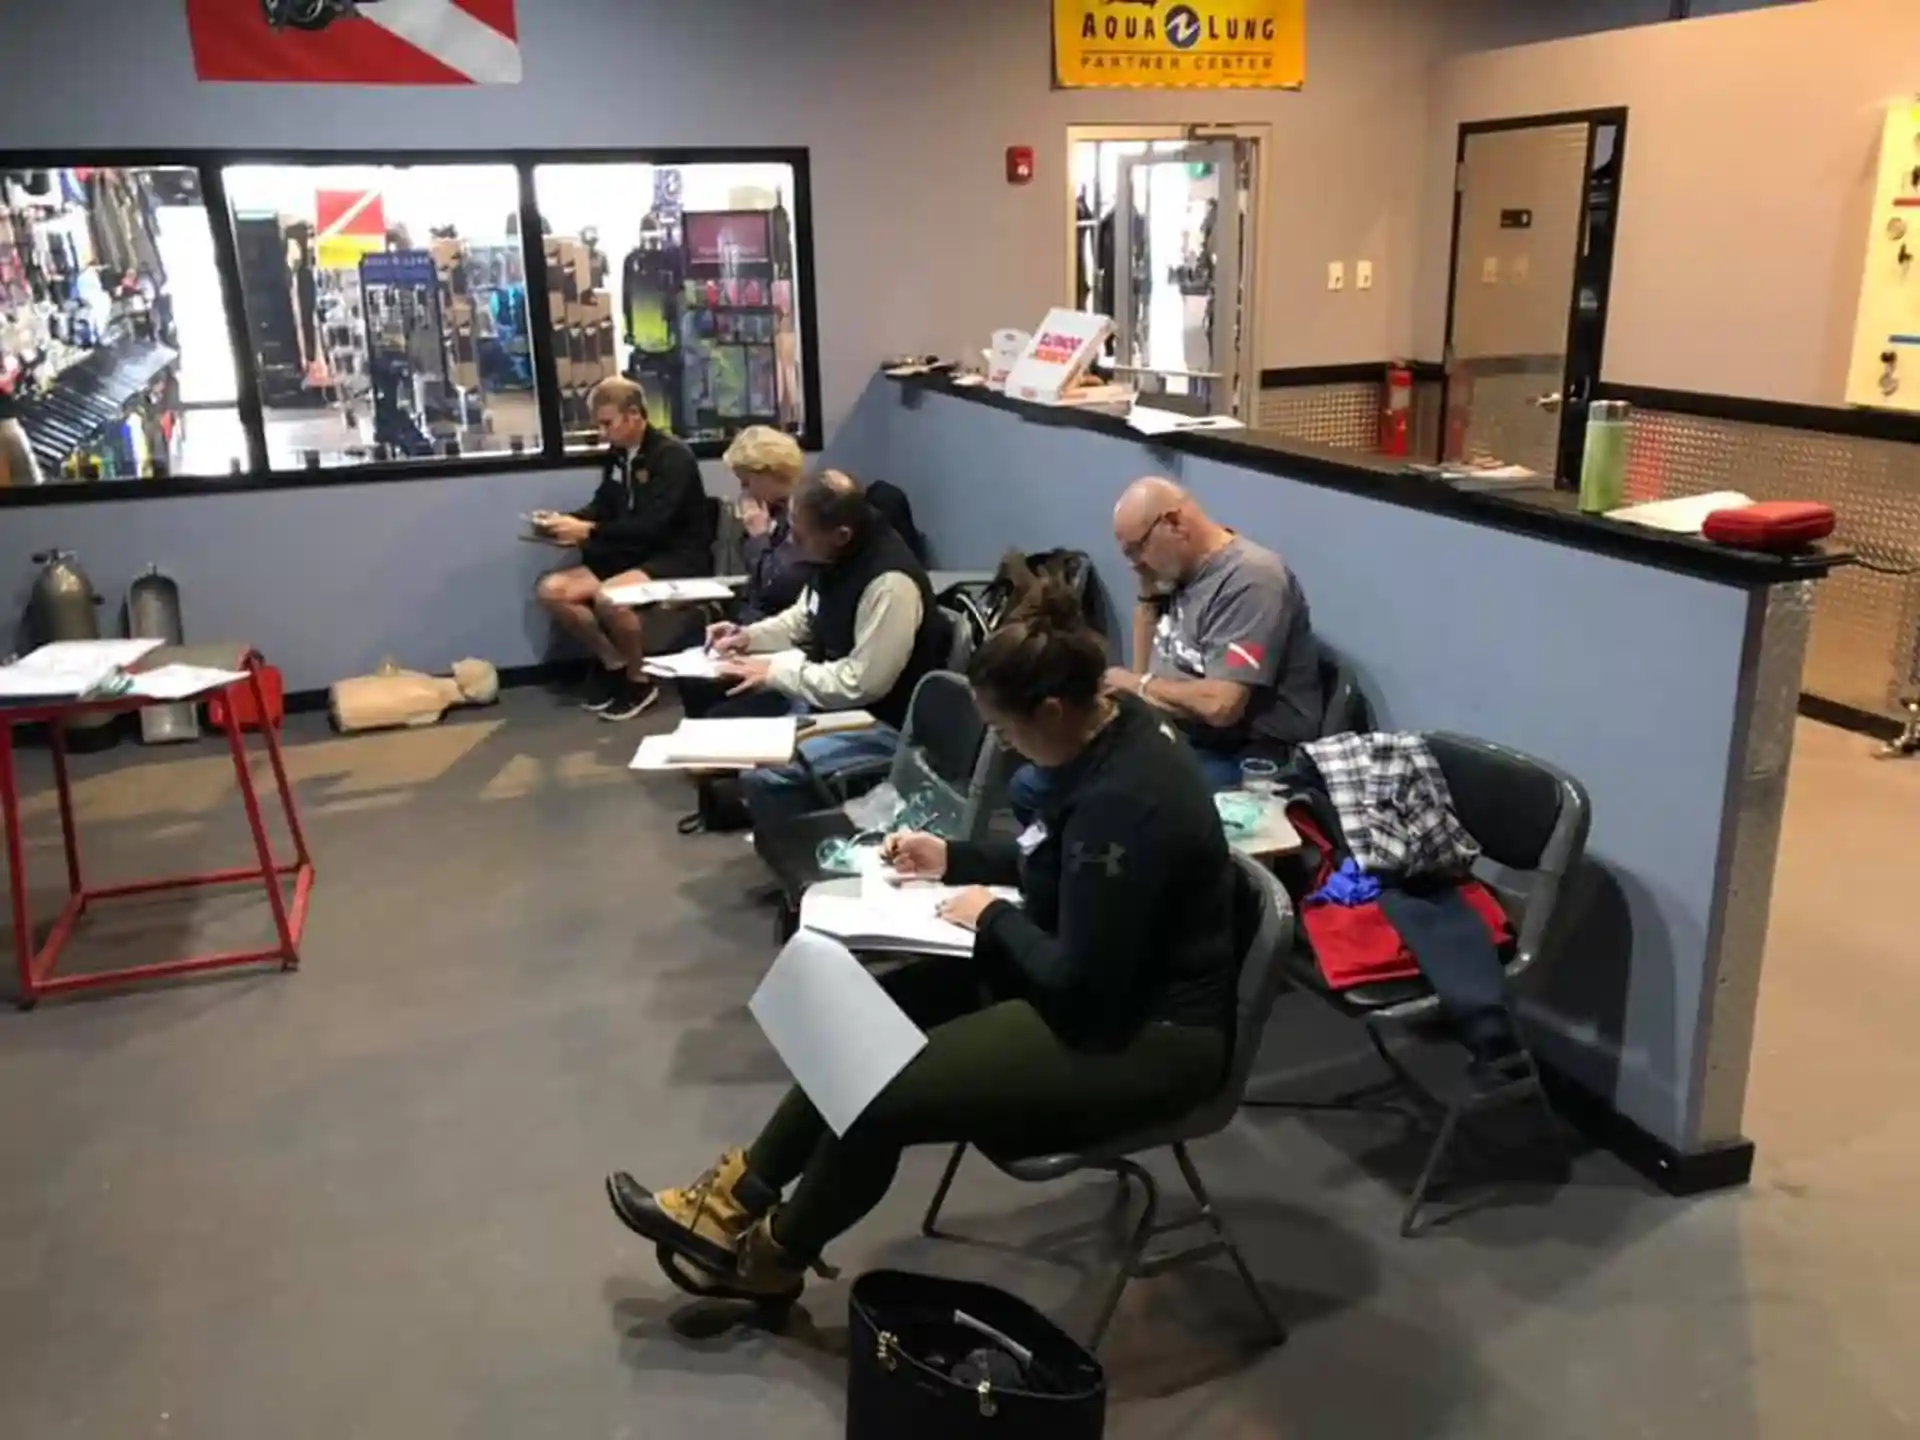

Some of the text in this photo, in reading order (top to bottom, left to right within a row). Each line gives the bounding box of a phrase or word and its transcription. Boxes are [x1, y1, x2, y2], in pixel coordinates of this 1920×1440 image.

[1081, 12, 1275, 41] AQUA LUNG
[1081, 55, 1273, 70] PARTNER CENTER
